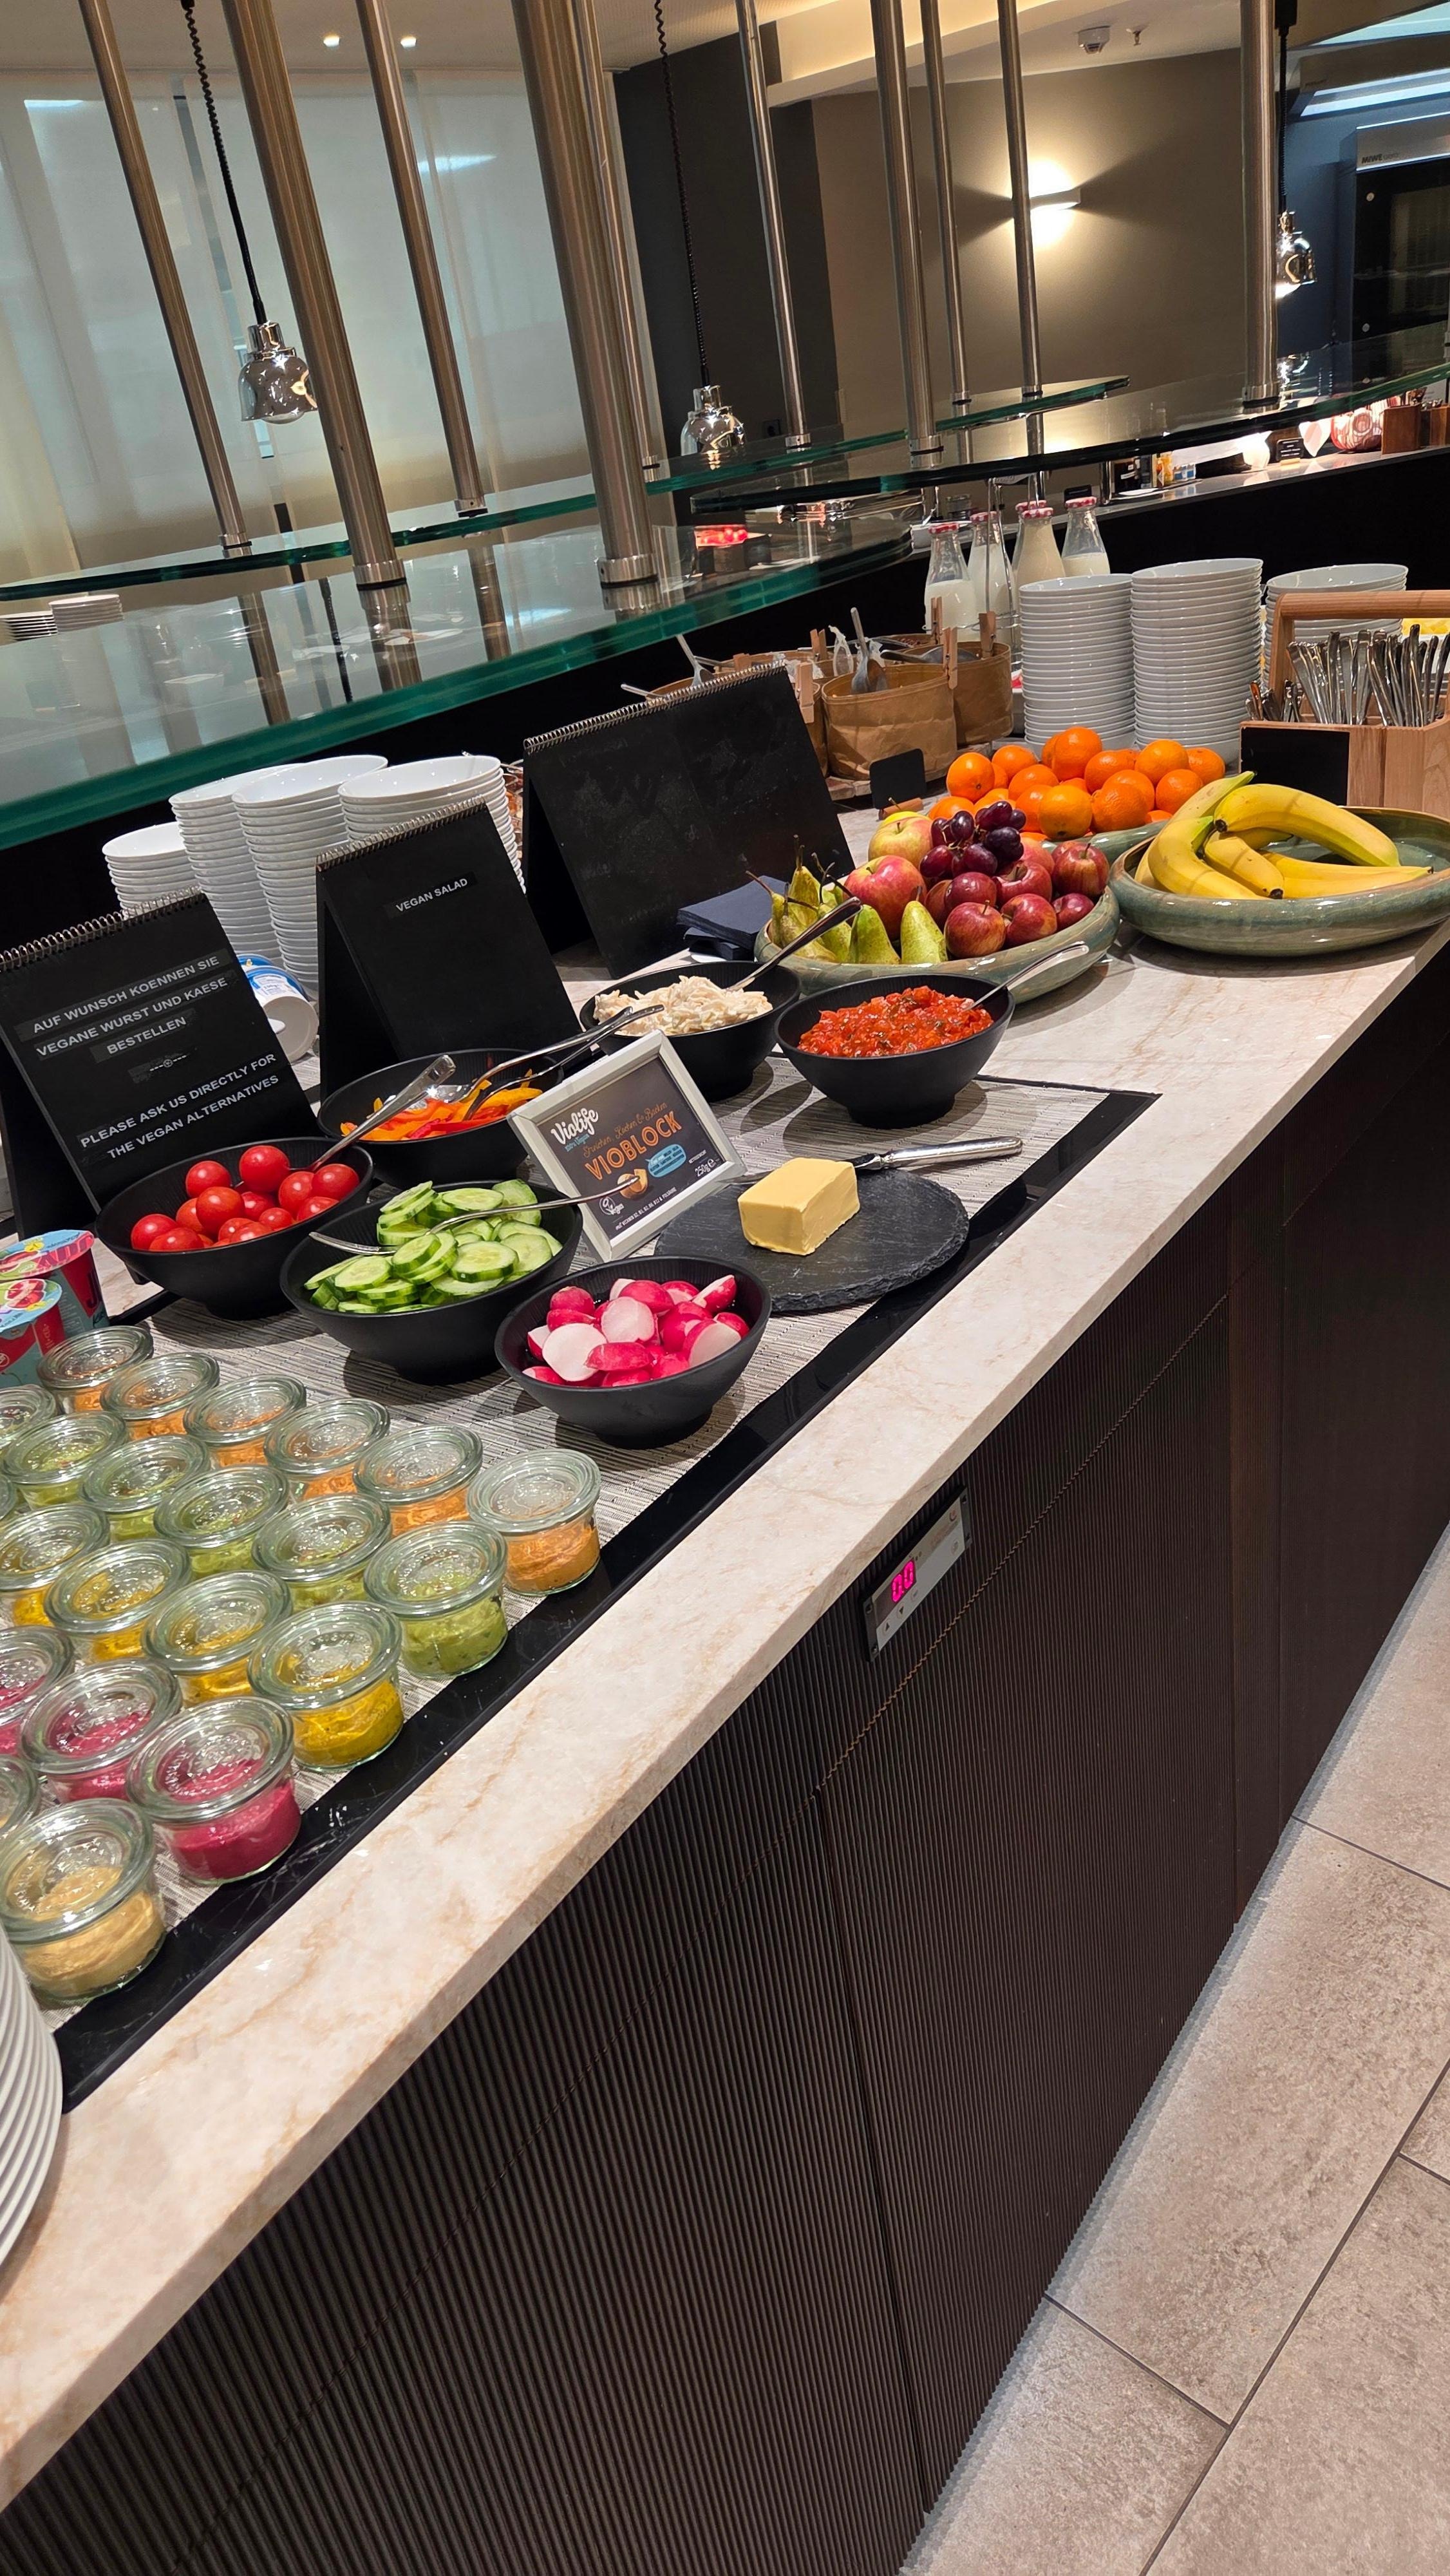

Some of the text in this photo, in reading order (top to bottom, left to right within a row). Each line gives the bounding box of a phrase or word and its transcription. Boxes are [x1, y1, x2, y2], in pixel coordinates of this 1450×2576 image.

[395, 878, 467, 911] VEGAN SALAD
[33, 956, 220, 1033] AUF WUNSCH KOENNEN SIE
[36, 977, 228, 1056] VEGANE WURST UND KAESE
[106, 1016, 187, 1054] BESTELLEN
[80, 1053, 276, 1148] PLEASE ASK US DIRECTLY FOR
[107, 1075, 279, 1159] THE VEGAN ALTERNATIVES
[551, 1108, 599, 1144] Violife
[585, 1110, 682, 1180] VIOBLOCK
